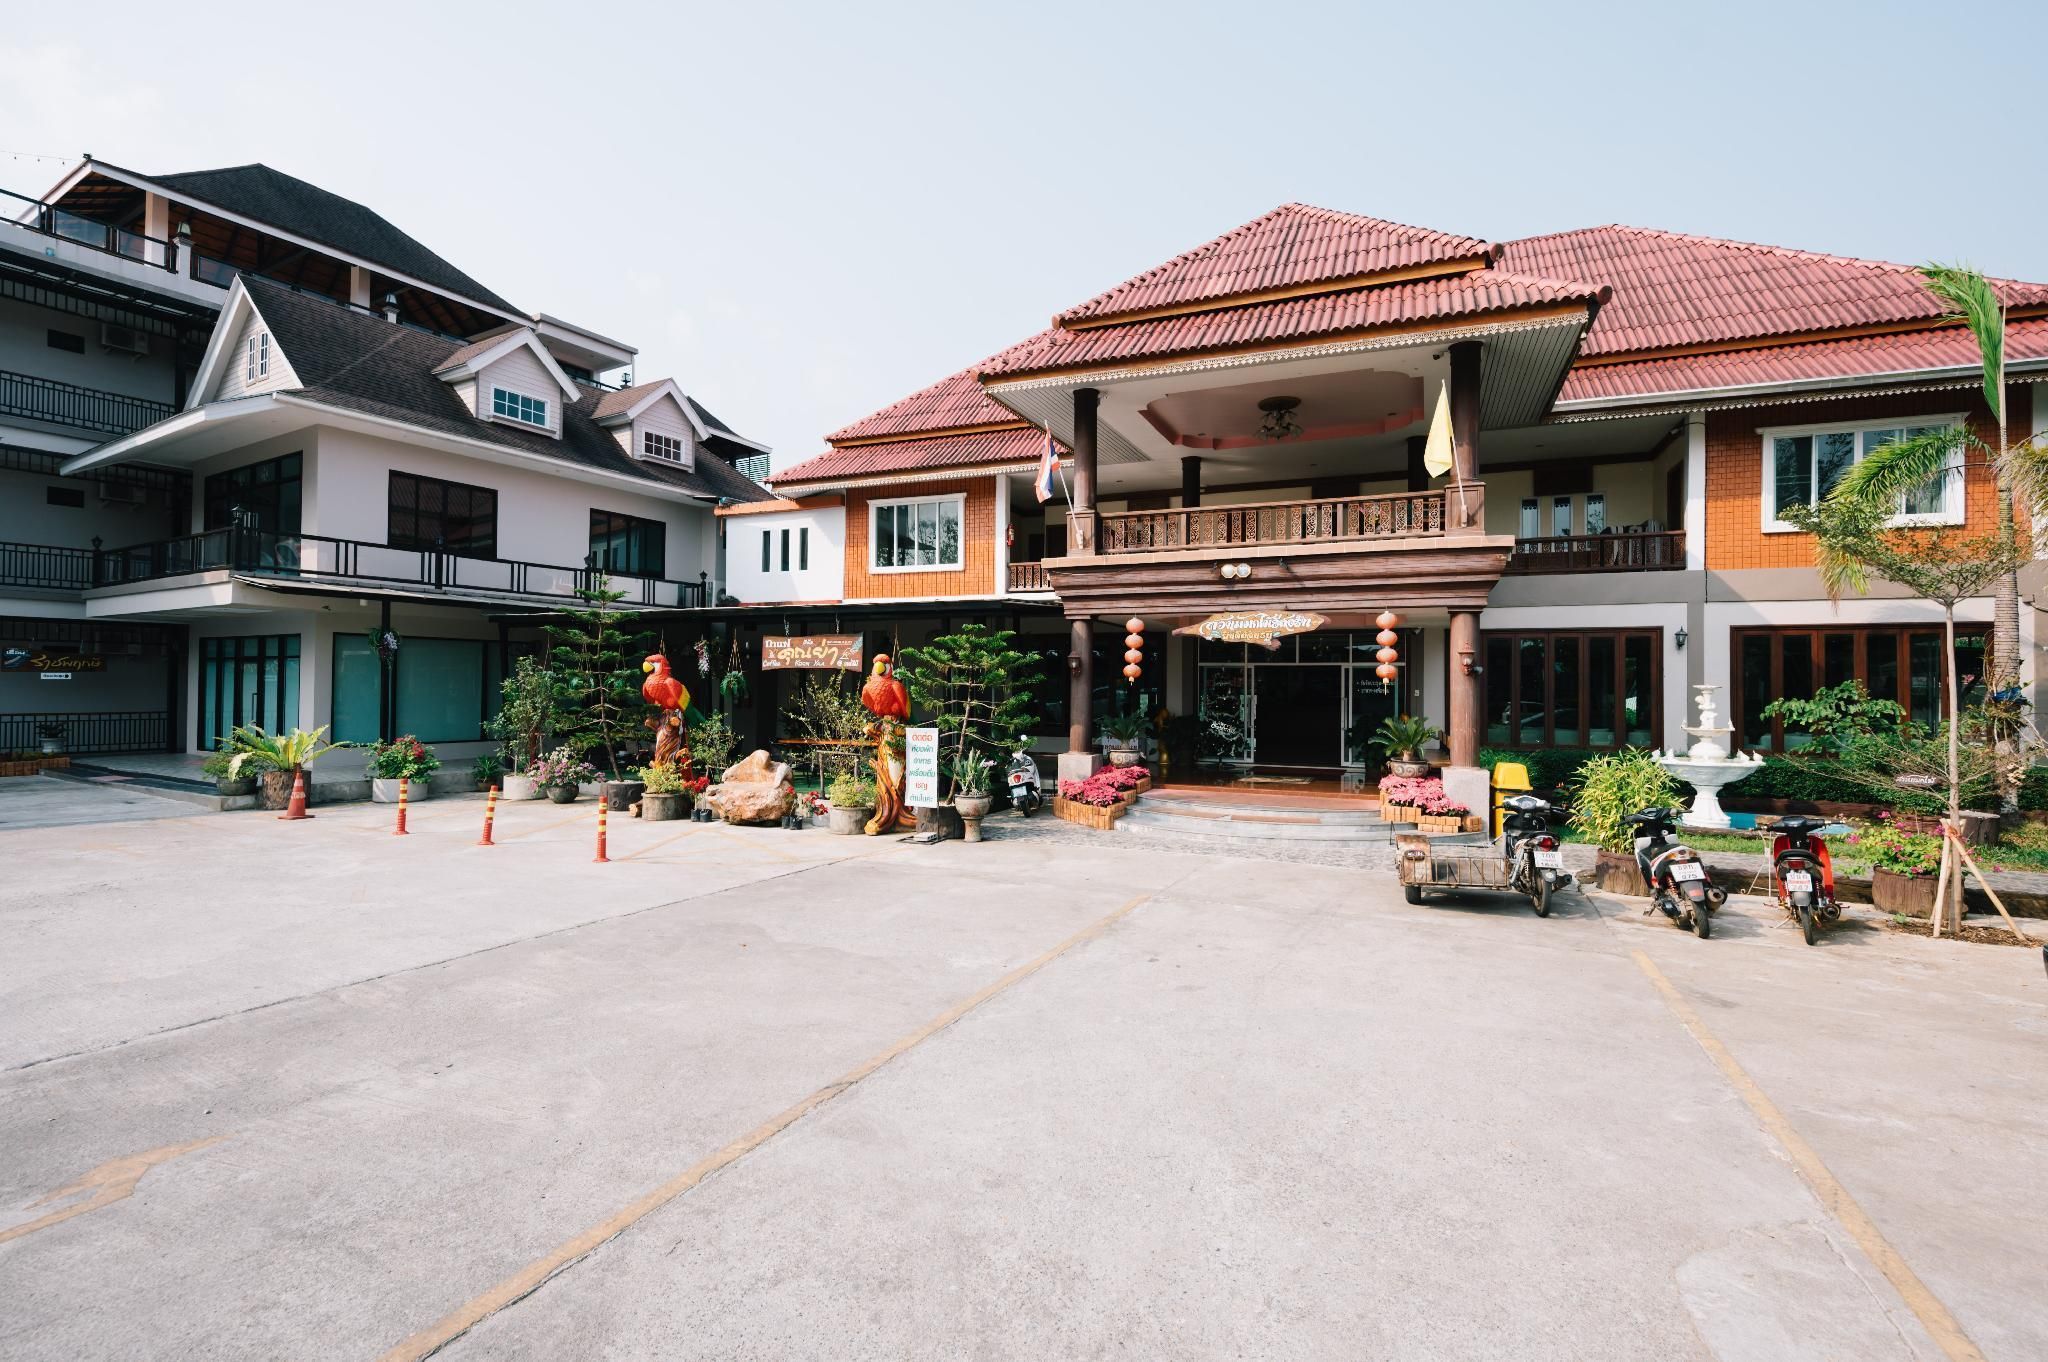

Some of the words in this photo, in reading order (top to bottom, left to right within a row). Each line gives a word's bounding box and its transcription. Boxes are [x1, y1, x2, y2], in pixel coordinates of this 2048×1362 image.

[765, 638, 791, 648] กาแฟ
[777, 638, 838, 666] คุณย่า
